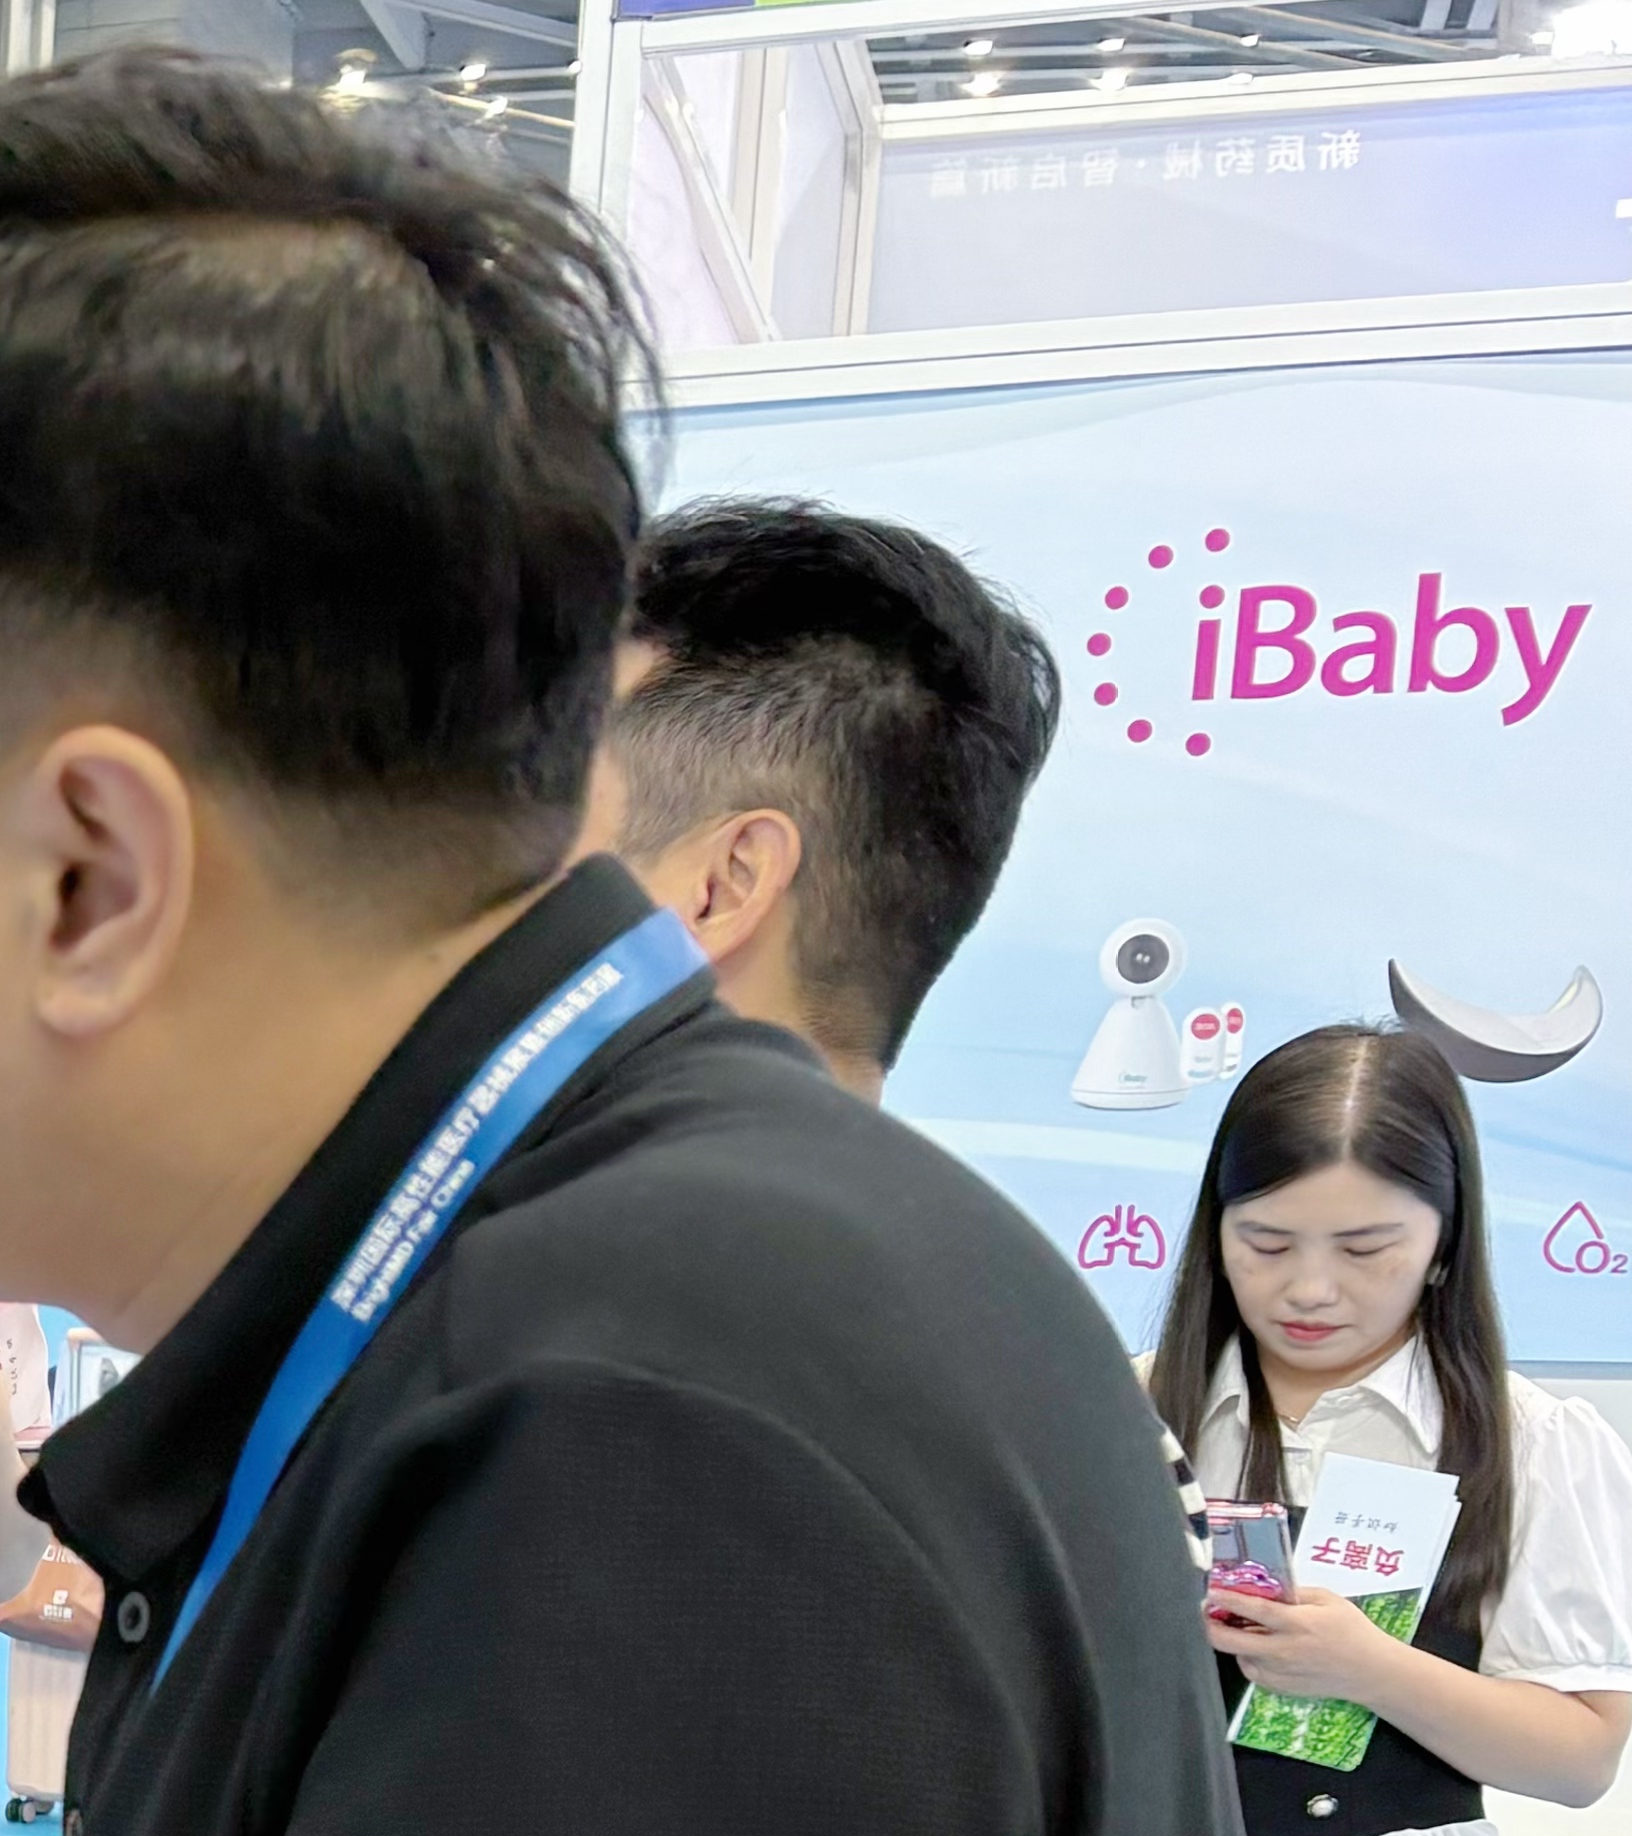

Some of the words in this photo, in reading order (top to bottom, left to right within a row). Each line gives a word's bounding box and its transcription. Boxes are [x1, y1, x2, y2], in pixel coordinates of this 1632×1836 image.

[1192, 572, 1592, 726] iBaby
[407, 1209, 439, 1243] Fair
[432, 1158, 475, 1207] China
[1311, 1537, 1404, 1576] 负离子
